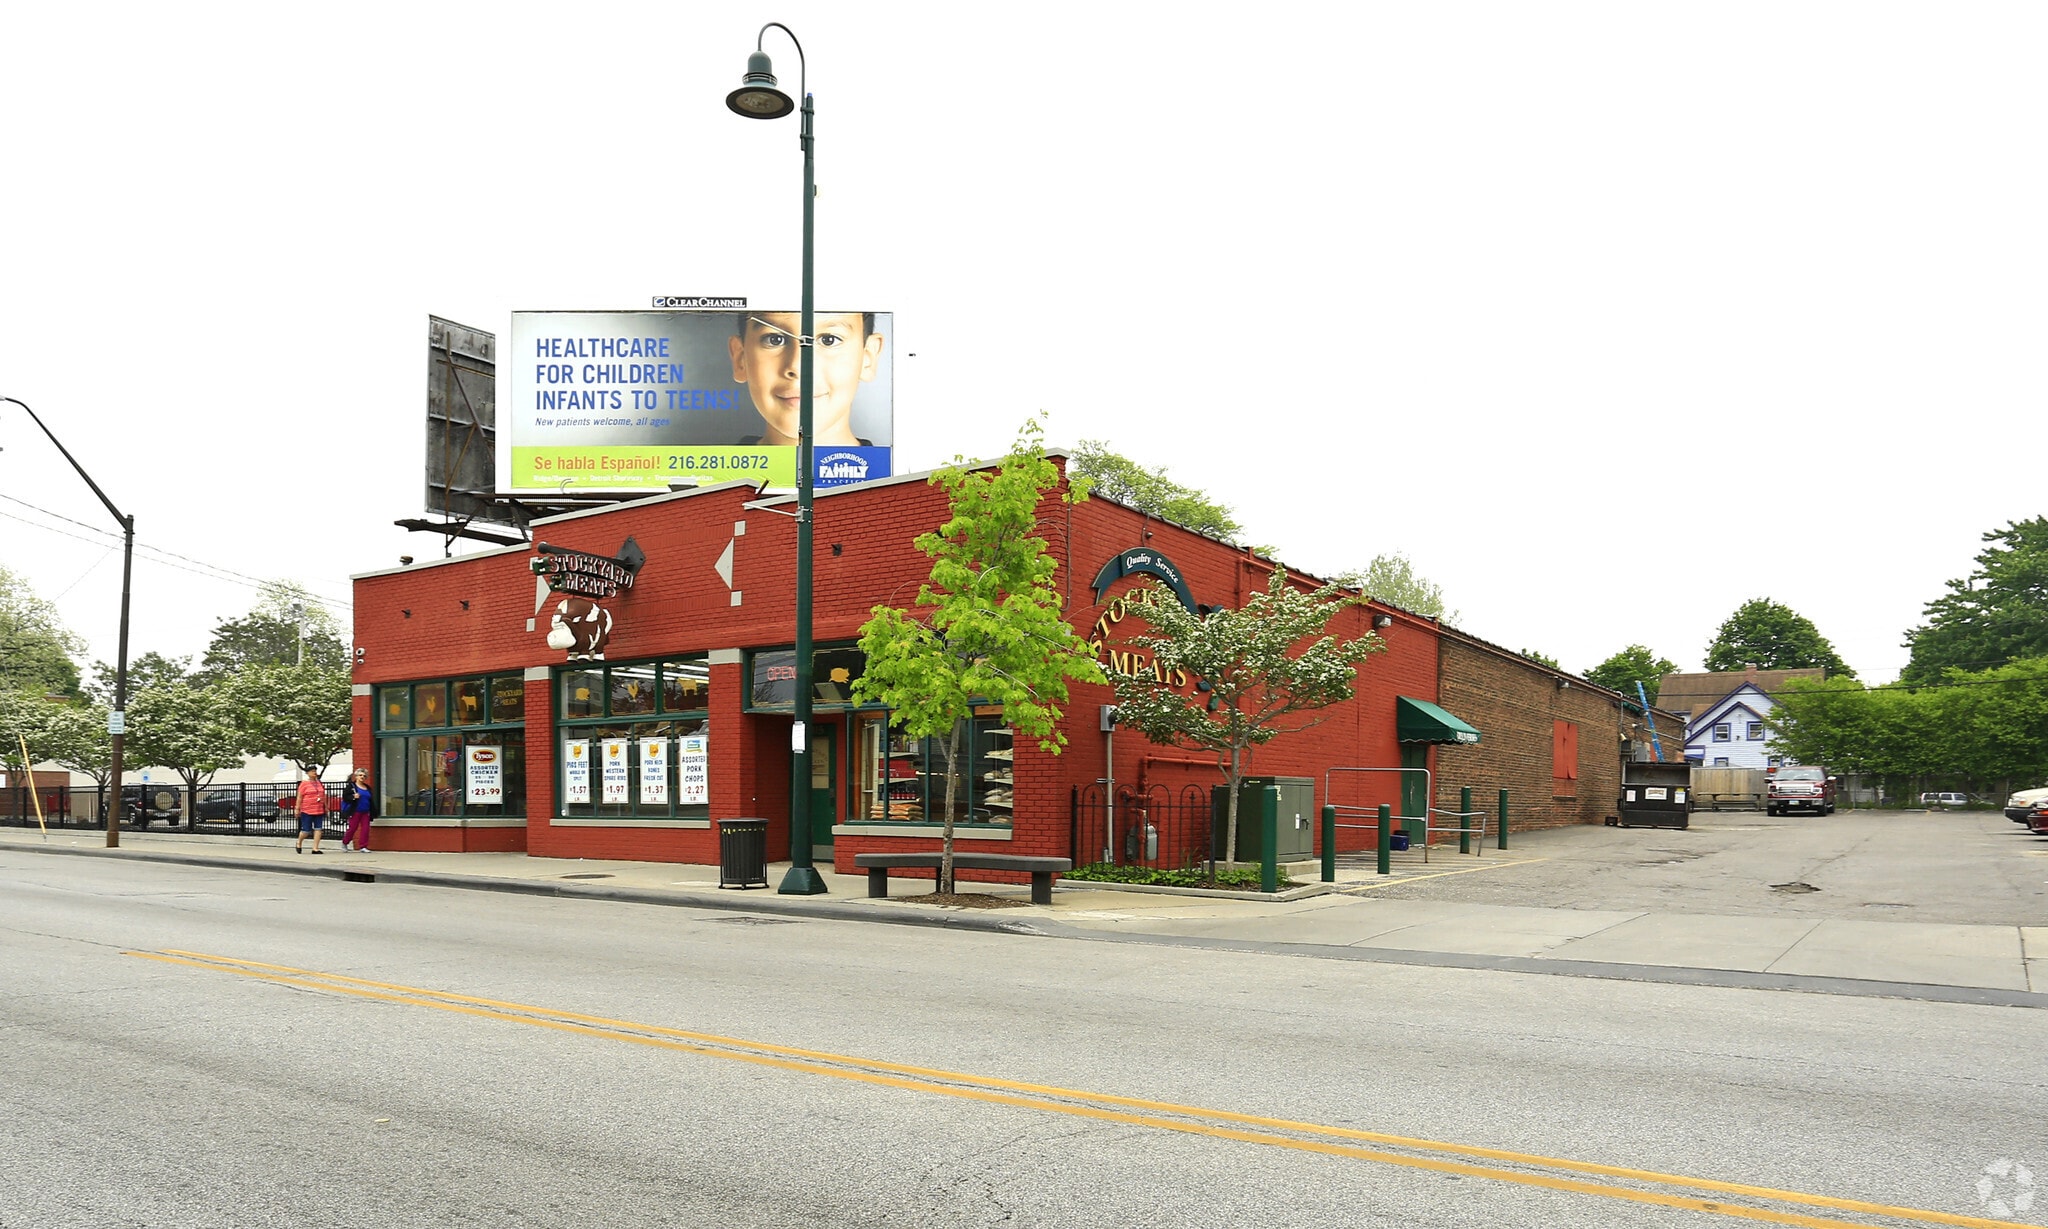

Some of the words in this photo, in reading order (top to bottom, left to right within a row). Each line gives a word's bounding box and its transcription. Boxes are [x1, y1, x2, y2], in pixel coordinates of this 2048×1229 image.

[536, 338, 670, 358] HEALTHCARE
[536, 364, 574, 384] FOR
[582, 364, 684, 384] CHILDREN
[536, 390, 622, 410] INFANTS
[631, 390, 657, 410] TO
[665, 390, 740, 410] TEENS!
[535, 418, 554, 427] New
[556, 417, 590, 428] patients
[593, 417, 633, 427] welcome,
[636, 417, 648, 426] all
[650, 418, 670, 428] ages
[534, 456, 552, 470] Se
[557, 456, 595, 470] habla
[601, 455, 660, 473] Español!
[668, 455, 769, 469] 216.281.0872
[820, 452, 868, 466] NEIGHBORHOOD
[819, 463, 869, 478] FAMILY
[548, 554, 634, 588] STOCKYARD
[1126, 553, 1151, 569] Quality
[1155, 558, 1179, 583] Service
[565, 572, 617, 597] MEATS
[767, 665, 797, 681] OPEN
[1109, 649, 1187, 687] MEATS
[475, 752, 494, 760] Tyson
[471, 788, 501, 796] $23.99
[570, 785, 587, 794] $1.57
[606, 785, 624, 794] $1.97
[644, 785, 664, 794] $1.37
